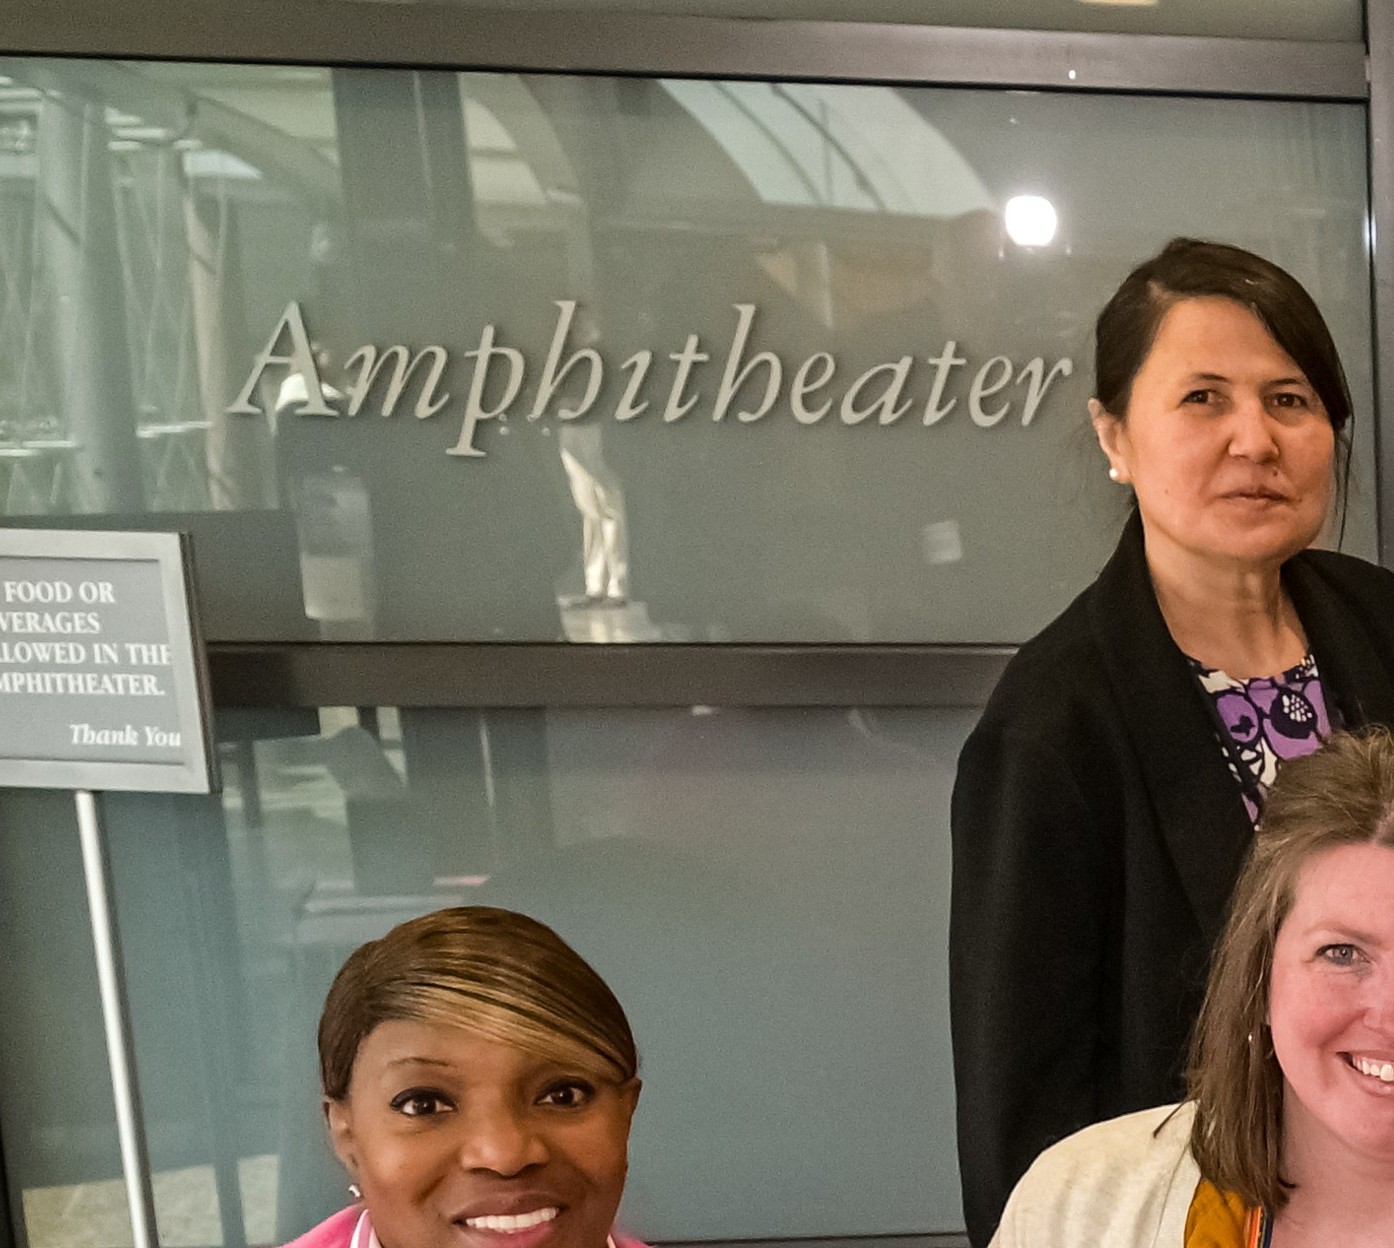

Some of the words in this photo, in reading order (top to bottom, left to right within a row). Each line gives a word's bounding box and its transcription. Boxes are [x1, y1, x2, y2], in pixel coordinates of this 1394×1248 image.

[225, 299, 1073, 458] Amphitheater
[5, 581, 72, 603] FOOD
[79, 582, 115, 603] OR
[0, 642, 86, 664] LOWED
[93, 643, 119, 665] IN
[124, 643, 171, 666] THE
[69, 723, 139, 746] Thank
[143, 725, 181, 747] You
